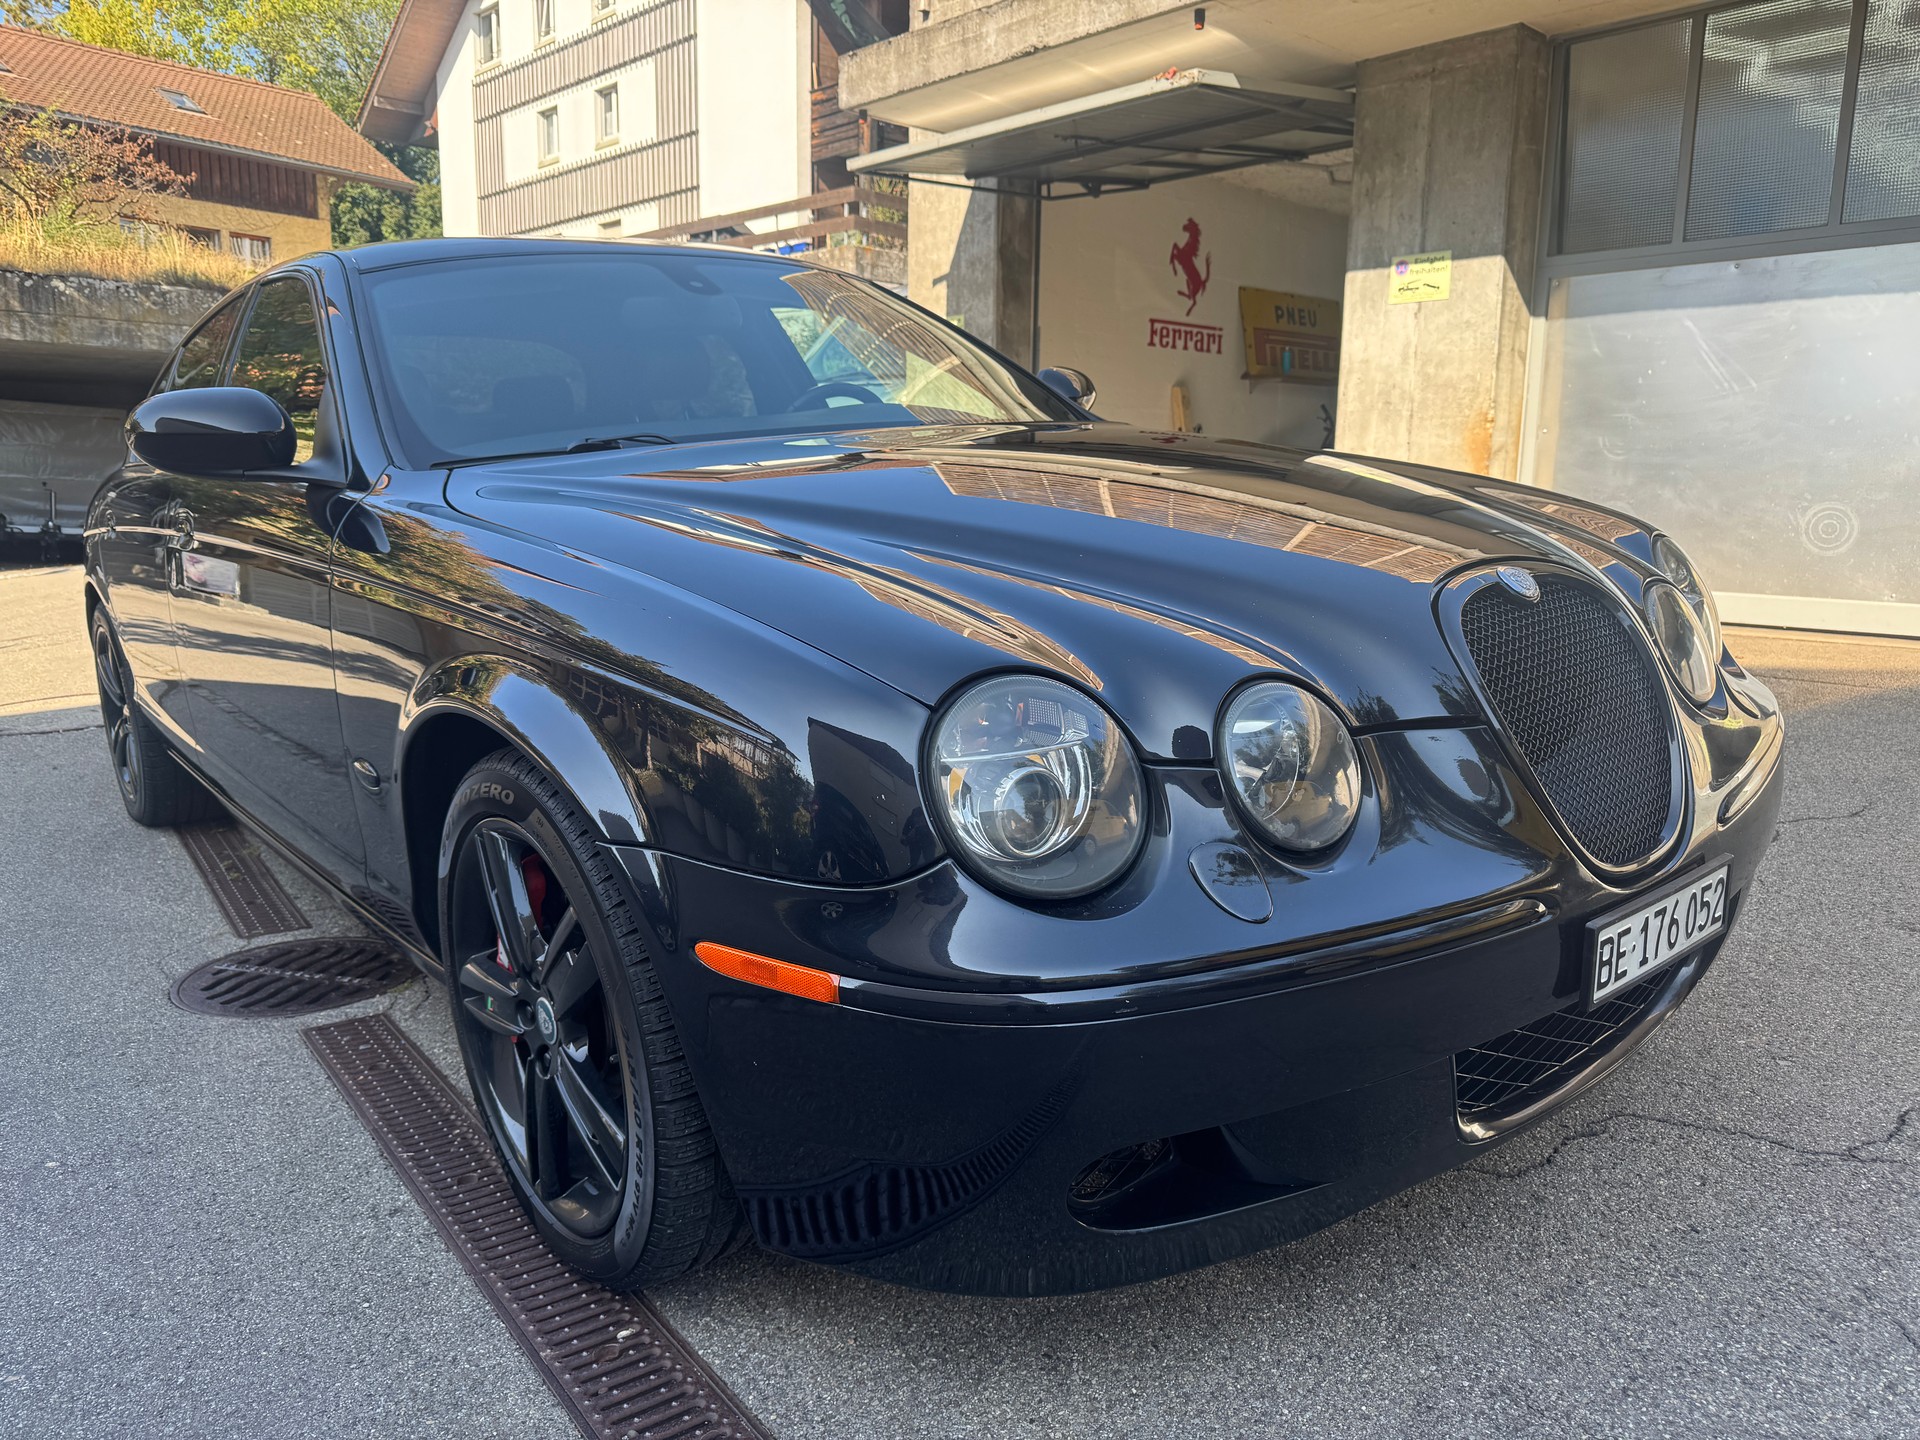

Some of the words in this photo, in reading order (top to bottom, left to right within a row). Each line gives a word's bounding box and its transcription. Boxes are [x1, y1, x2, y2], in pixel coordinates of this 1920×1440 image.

[1274, 305, 1318, 328] PNEU
[1147, 318, 1223, 355] Ferrari
[634, 1132, 644, 1179] R18
